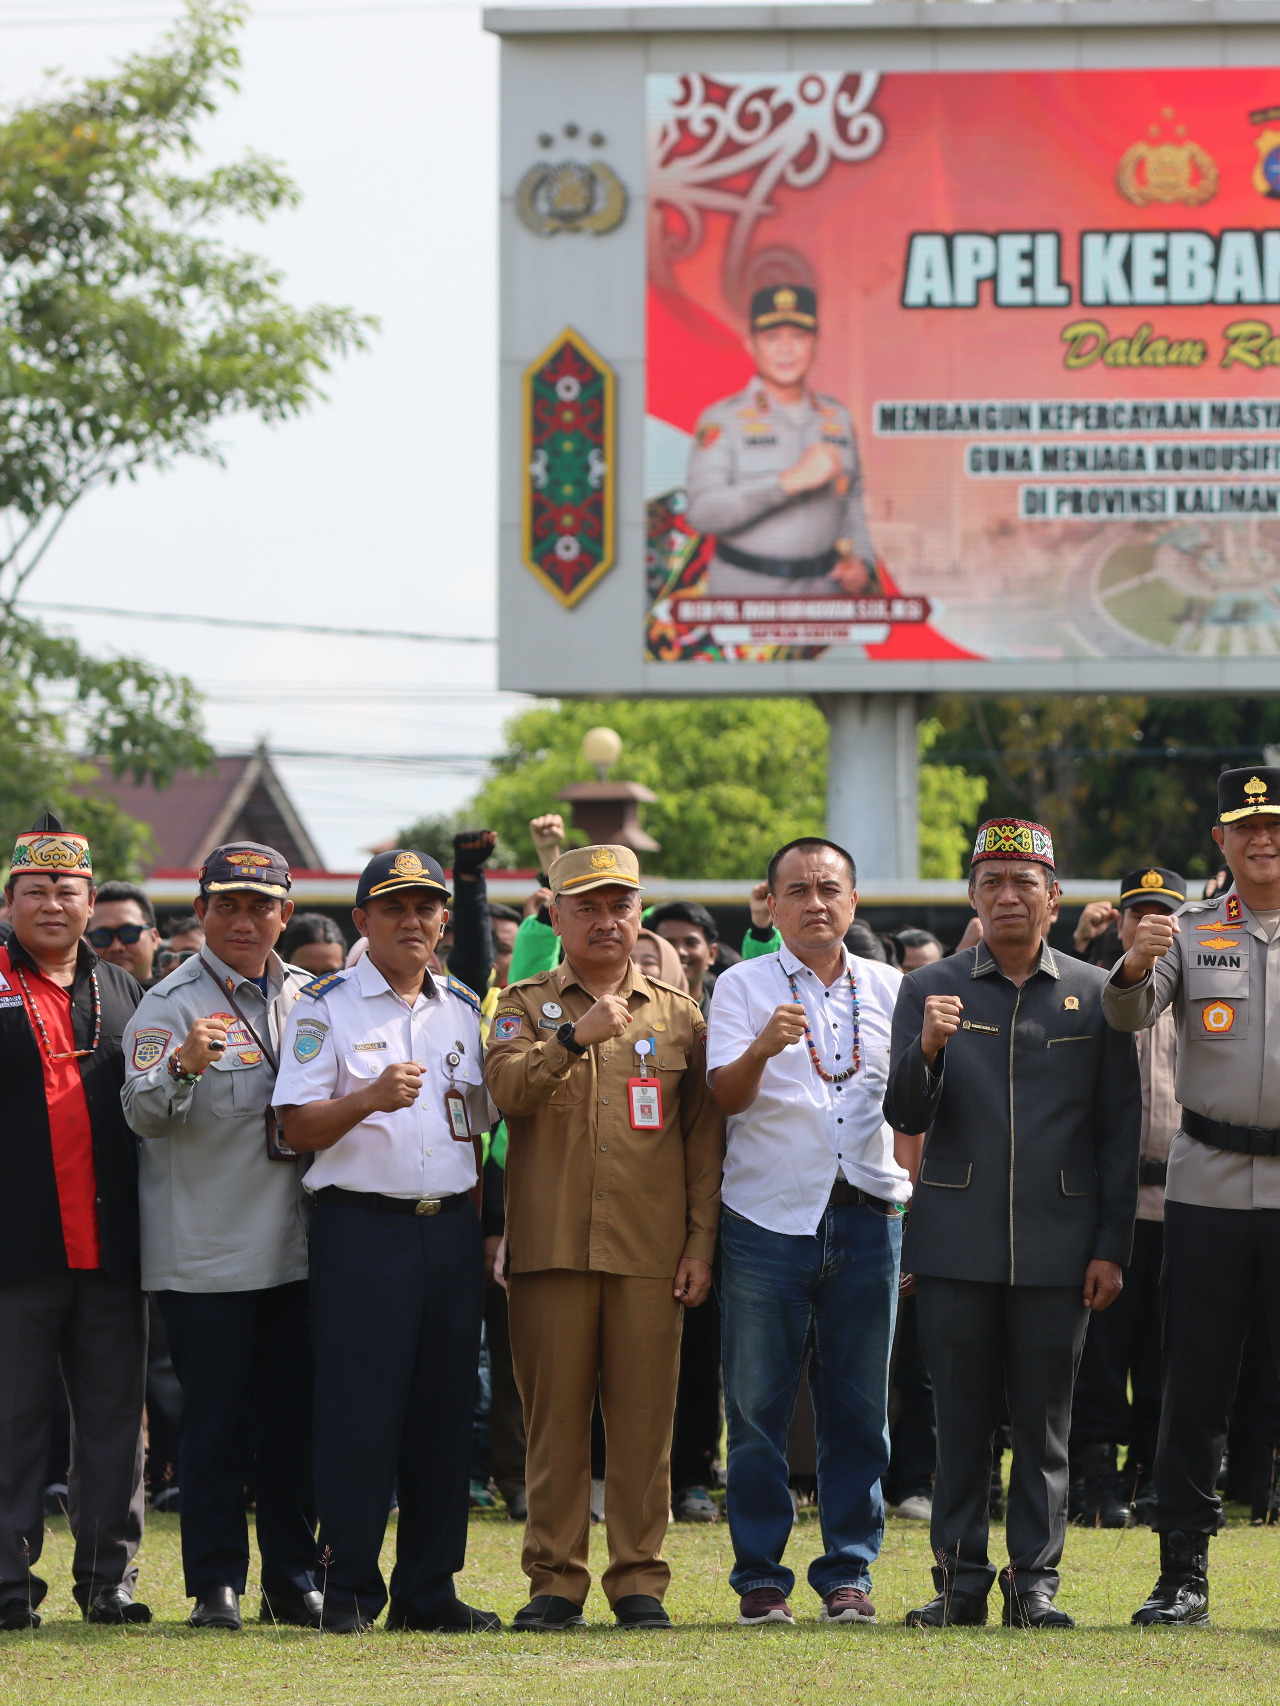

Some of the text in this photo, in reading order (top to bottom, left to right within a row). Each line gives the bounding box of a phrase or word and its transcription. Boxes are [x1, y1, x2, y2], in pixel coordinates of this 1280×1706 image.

[902, 231, 1071, 307] APEL
[1061, 320, 1207, 369] Dalam
[878, 405, 1031, 432] MEMBANGUN
[1039, 403, 1201, 430] KEPERCAYAAN
[969, 445, 1034, 473] GUNA
[1041, 445, 1147, 472] MENJAGA
[1025, 489, 1047, 515] DI
[1056, 489, 1167, 515] PROVINSI
[1197, 953, 1241, 969] IWAN
